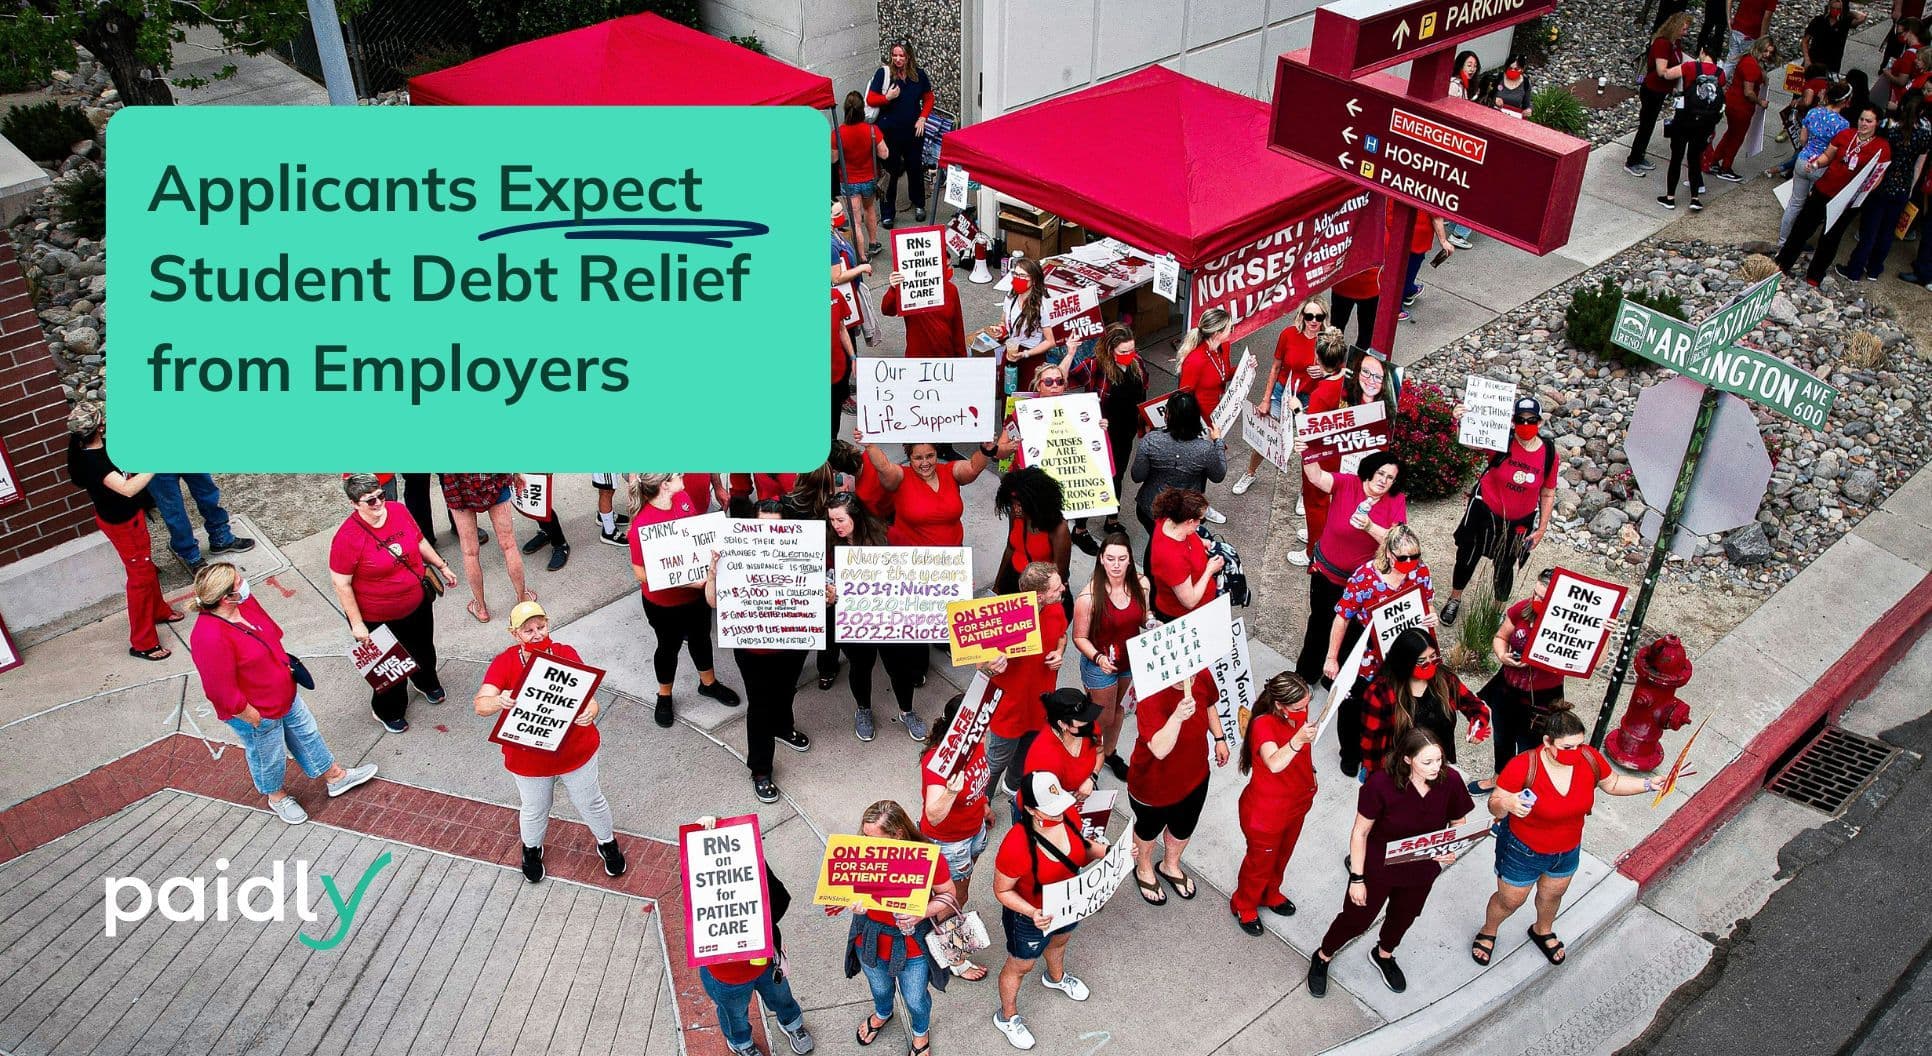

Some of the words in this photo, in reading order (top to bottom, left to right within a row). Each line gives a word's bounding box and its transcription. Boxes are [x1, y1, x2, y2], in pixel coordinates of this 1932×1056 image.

[1393, 114, 1484, 157] EMERGENCY
[1384, 142, 1471, 189] HOSPITAL
[1380, 169, 1460, 212] PARKING
[1325, 220, 1351, 239] Our
[906, 238, 932, 250] RNs
[901, 257, 939, 270] STRIKE
[914, 250, 925, 258] on
[902, 277, 941, 290] PATIENT
[914, 269, 928, 279] for
[909, 287, 935, 300] CARE
[1053, 294, 1080, 311] SAFE
[1049, 305, 1081, 320] STAFFING
[1718, 291, 1764, 345] SIXTH
[1063, 316, 1091, 331] SAVES
[1618, 332, 1641, 350] RENO
[875, 360, 904, 382] Our
[919, 362, 954, 383] ICU
[1646, 327, 1657, 344] N
[1653, 327, 1799, 409] ARINGTON
[1801, 381, 1831, 407] AVE
[876, 386, 894, 401] is
[914, 387, 940, 401] on
[864, 404, 907, 435] Life
[1053, 408, 1065, 418] IF
[1308, 410, 1355, 428] SAFE
[1793, 401, 1824, 426] 600
[1300, 421, 1356, 436] STAFFING
[1323, 429, 1371, 446] SAVES
[1046, 437, 1083, 448] NURSES
[1056, 446, 1078, 456] ARE
[1337, 434, 1388, 453] LIVES
[1041, 455, 1088, 467] OUTSIDE
[1056, 465, 1087, 476] THEN
[640, 521, 678, 541] SMRMC
[660, 554, 685, 570] THAN
[692, 552, 700, 564] A
[847, 548, 909, 565] Nurses
[911, 548, 965, 566] labeled
[669, 571, 682, 585] BP
[840, 568, 881, 581] over
[886, 565, 917, 581] the
[919, 569, 968, 585] years
[1566, 583, 1602, 606] RNs
[954, 608, 976, 624] ON
[979, 595, 1030, 619] STRIKE
[1384, 601, 1411, 620] RNs
[1573, 600, 1588, 613] on
[958, 623, 978, 634] FOR
[979, 617, 1003, 629] SAFE
[1393, 614, 1405, 624] on
[1550, 605, 1603, 629] STRIKE
[960, 626, 1004, 645] PATIENT
[1005, 619, 1034, 633] CARE
[1140, 619, 1187, 648] SOME
[1381, 614, 1422, 641] STRIKE
[1562, 622, 1582, 636] for
[1152, 627, 1198, 656] CUTS
[1541, 628, 1595, 651] PATIENT
[1146, 639, 1201, 673] NEVER
[1546, 642, 1580, 661] CARE
[373, 655, 401, 677] SAVES
[385, 657, 417, 682] LIVES
[1161, 654, 1204, 681] HEAL
[1215, 661, 1229, 685] far
[543, 666, 579, 688] RNs
[548, 682, 564, 695] on
[1235, 669, 1250, 707] Your
[524, 686, 578, 710] STRIKE
[1219, 688, 1232, 718] cry
[512, 707, 568, 730] PATIENT
[536, 702, 555, 716] for
[516, 721, 553, 739] CARE
[939, 706, 971, 760] SAFE
[1224, 719, 1236, 747] from
[703, 835, 741, 856] RNs
[1400, 829, 1457, 850] SAFE
[716, 856, 731, 867] on
[833, 846, 861, 860] ON
[864, 846, 929, 861] STRIKE
[834, 861, 857, 871] FOR
[859, 861, 889, 872] SAFE
[695, 866, 754, 888] STRIKE
[832, 872, 887, 884] PATIENT
[889, 873, 925, 885] CARE
[716, 887, 736, 902] for
[697, 900, 758, 921] PATIENT
[708, 920, 749, 937] CARE
